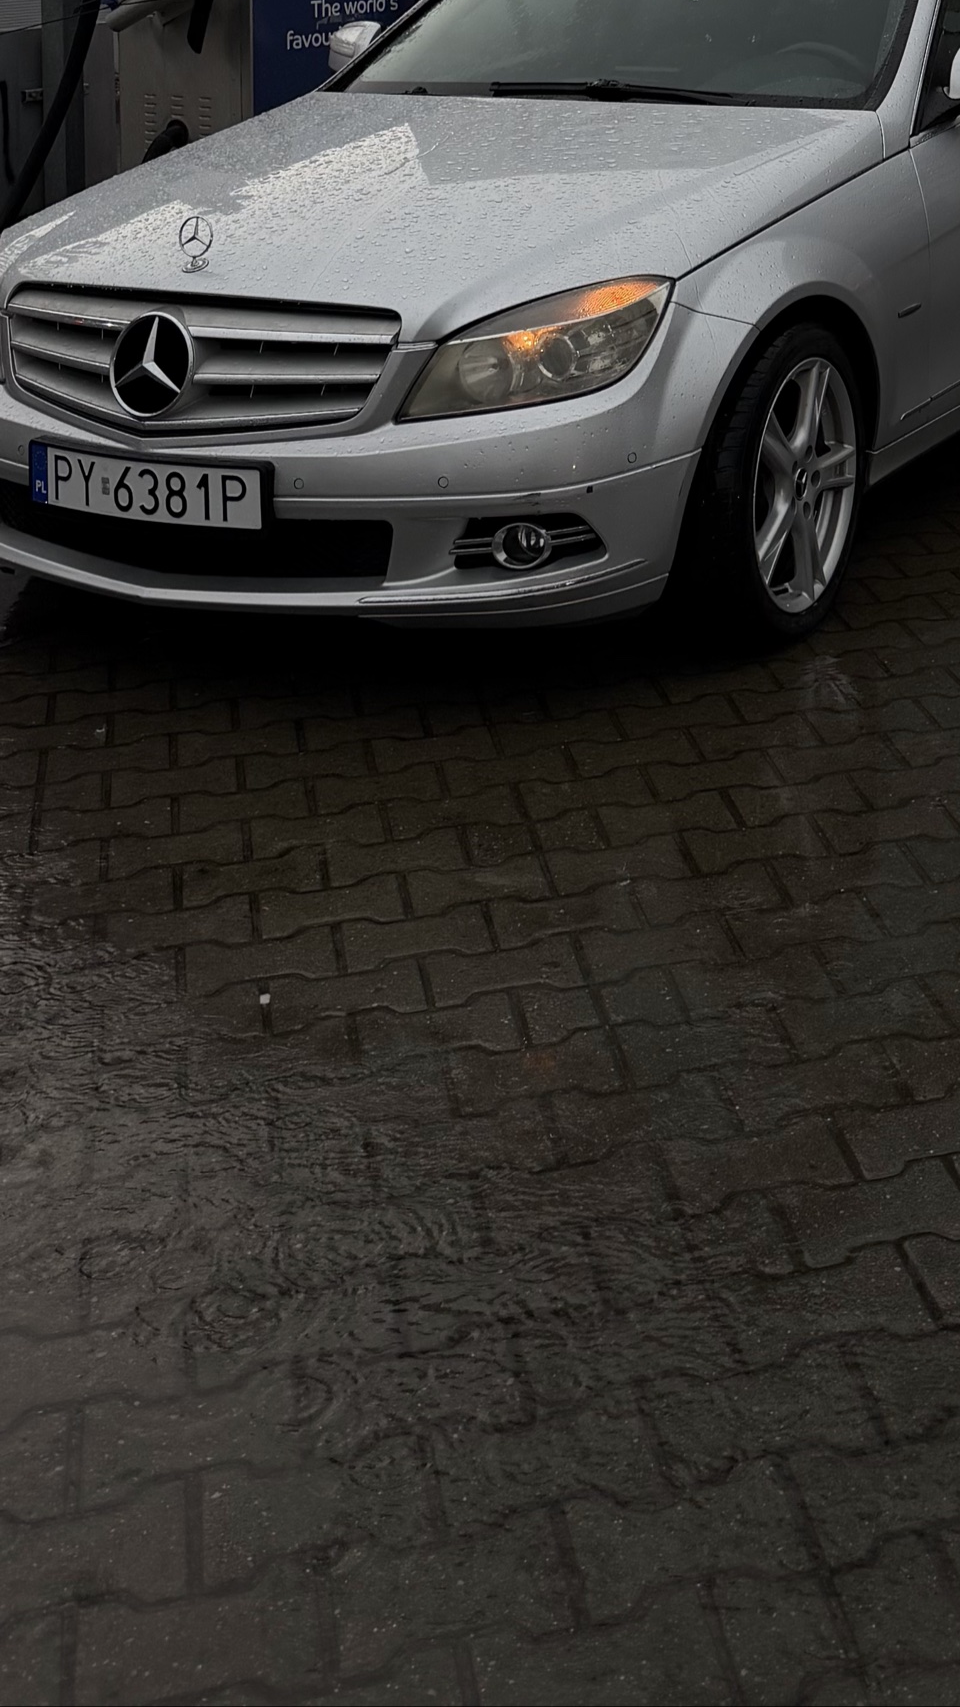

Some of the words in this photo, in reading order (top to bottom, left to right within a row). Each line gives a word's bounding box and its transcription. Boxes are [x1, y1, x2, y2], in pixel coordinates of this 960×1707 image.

[286, 30, 333, 51] favou
[35, 480, 47, 495] PL
[54, 454, 96, 507] PY
[113, 466, 247, 523] 6381P
